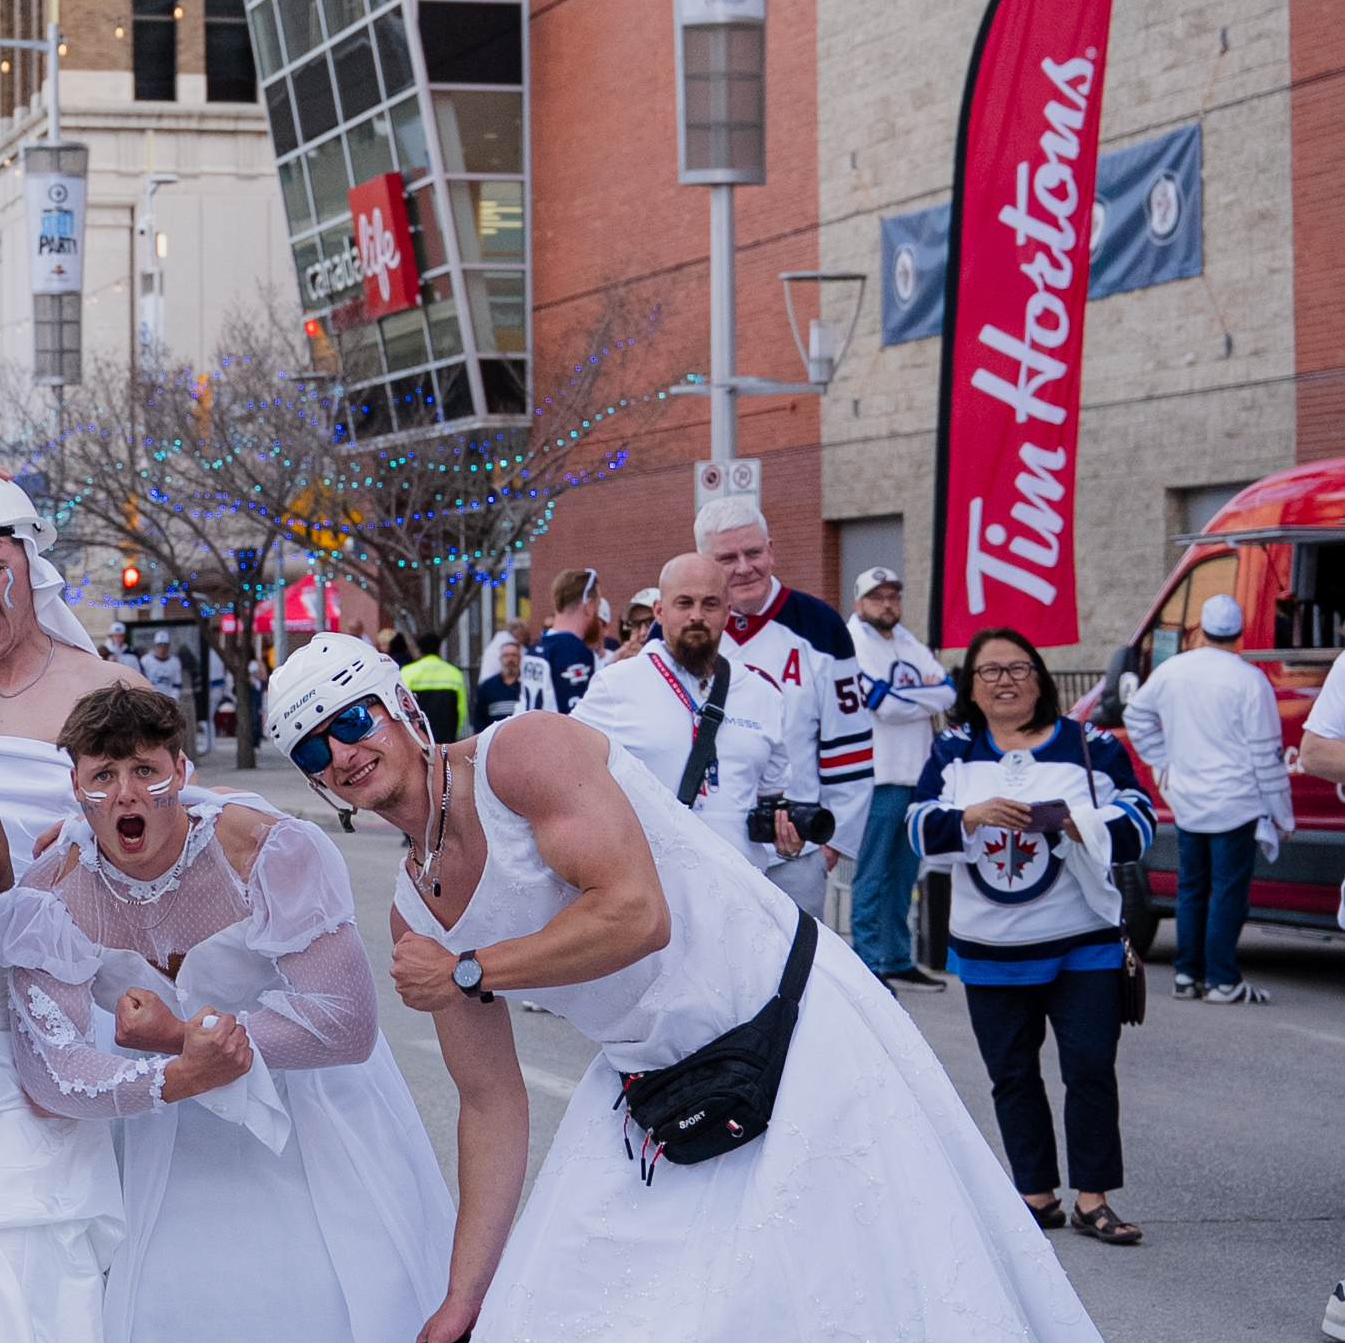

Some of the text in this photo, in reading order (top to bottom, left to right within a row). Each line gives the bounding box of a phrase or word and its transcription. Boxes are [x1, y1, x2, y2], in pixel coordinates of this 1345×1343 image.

[358, 207, 401, 301] life
[966, 55, 1095, 615] Tim Hortons
[782, 648, 801, 686] A
